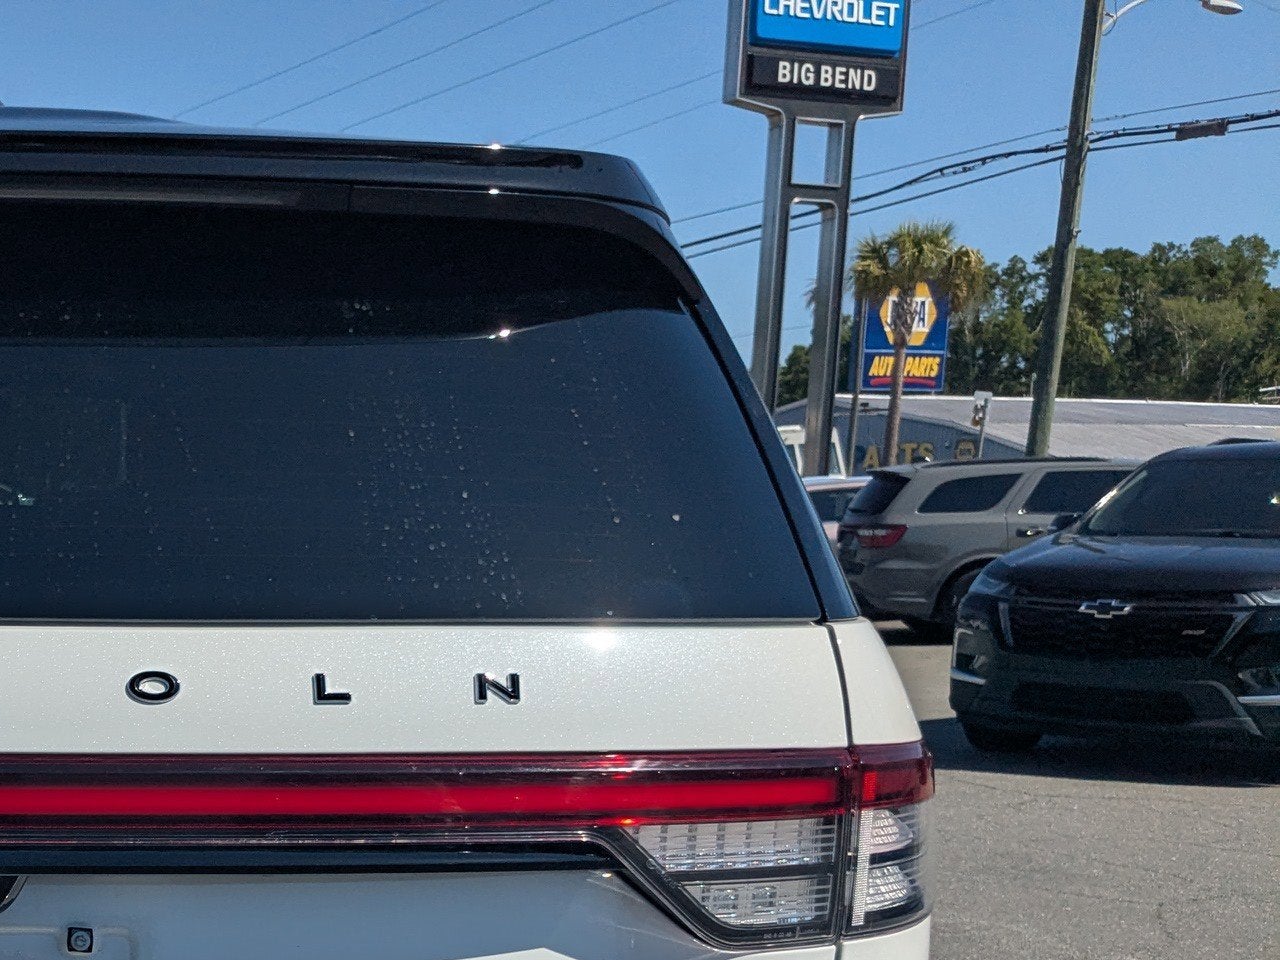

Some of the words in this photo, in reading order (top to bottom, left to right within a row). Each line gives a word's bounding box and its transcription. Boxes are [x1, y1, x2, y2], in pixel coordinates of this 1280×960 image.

[763, 0, 900, 27] CHEVROLET
[777, 61, 815, 86] BIG
[820, 65, 877, 91] BEND
[868, 355, 902, 376] AUT
[903, 355, 941, 378] PARTS
